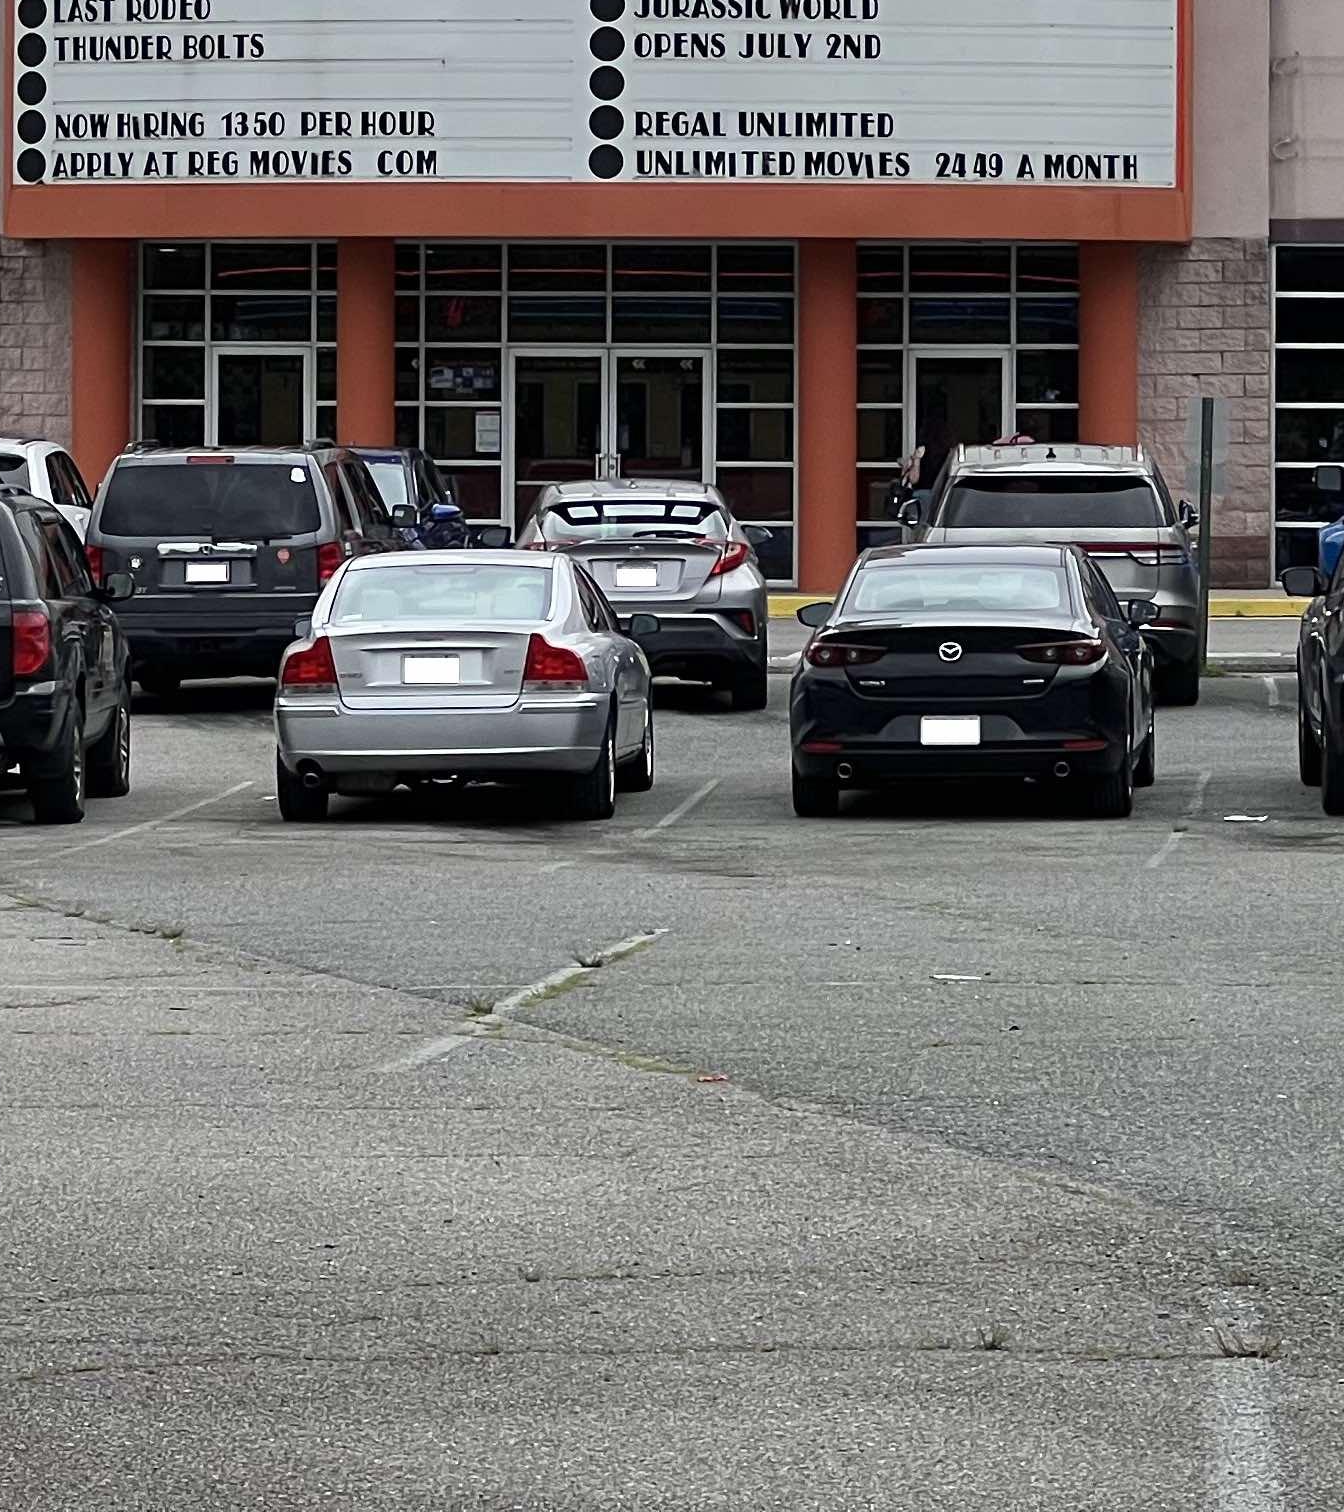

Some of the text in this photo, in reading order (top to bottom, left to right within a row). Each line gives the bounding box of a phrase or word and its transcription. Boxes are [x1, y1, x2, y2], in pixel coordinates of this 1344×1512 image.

[53, 33, 266, 62] THUNDER BOLTS
[634, 32, 882, 60] OPENS JULY 2ND
[55, 113, 111, 139] NOW
[117, 111, 206, 141] HIRING
[300, 111, 353, 138] PER
[360, 110, 436, 137] HOUR
[635, 111, 895, 139] REGAL UNLIMITED
[51, 150, 438, 178] APPLY AT REG MOVIES COM
[636, 150, 796, 178] UNLIMITED
[804, 150, 911, 179] MOVIES
[1016, 154, 1035, 179] A
[1044, 154, 1138, 180] MONTH
